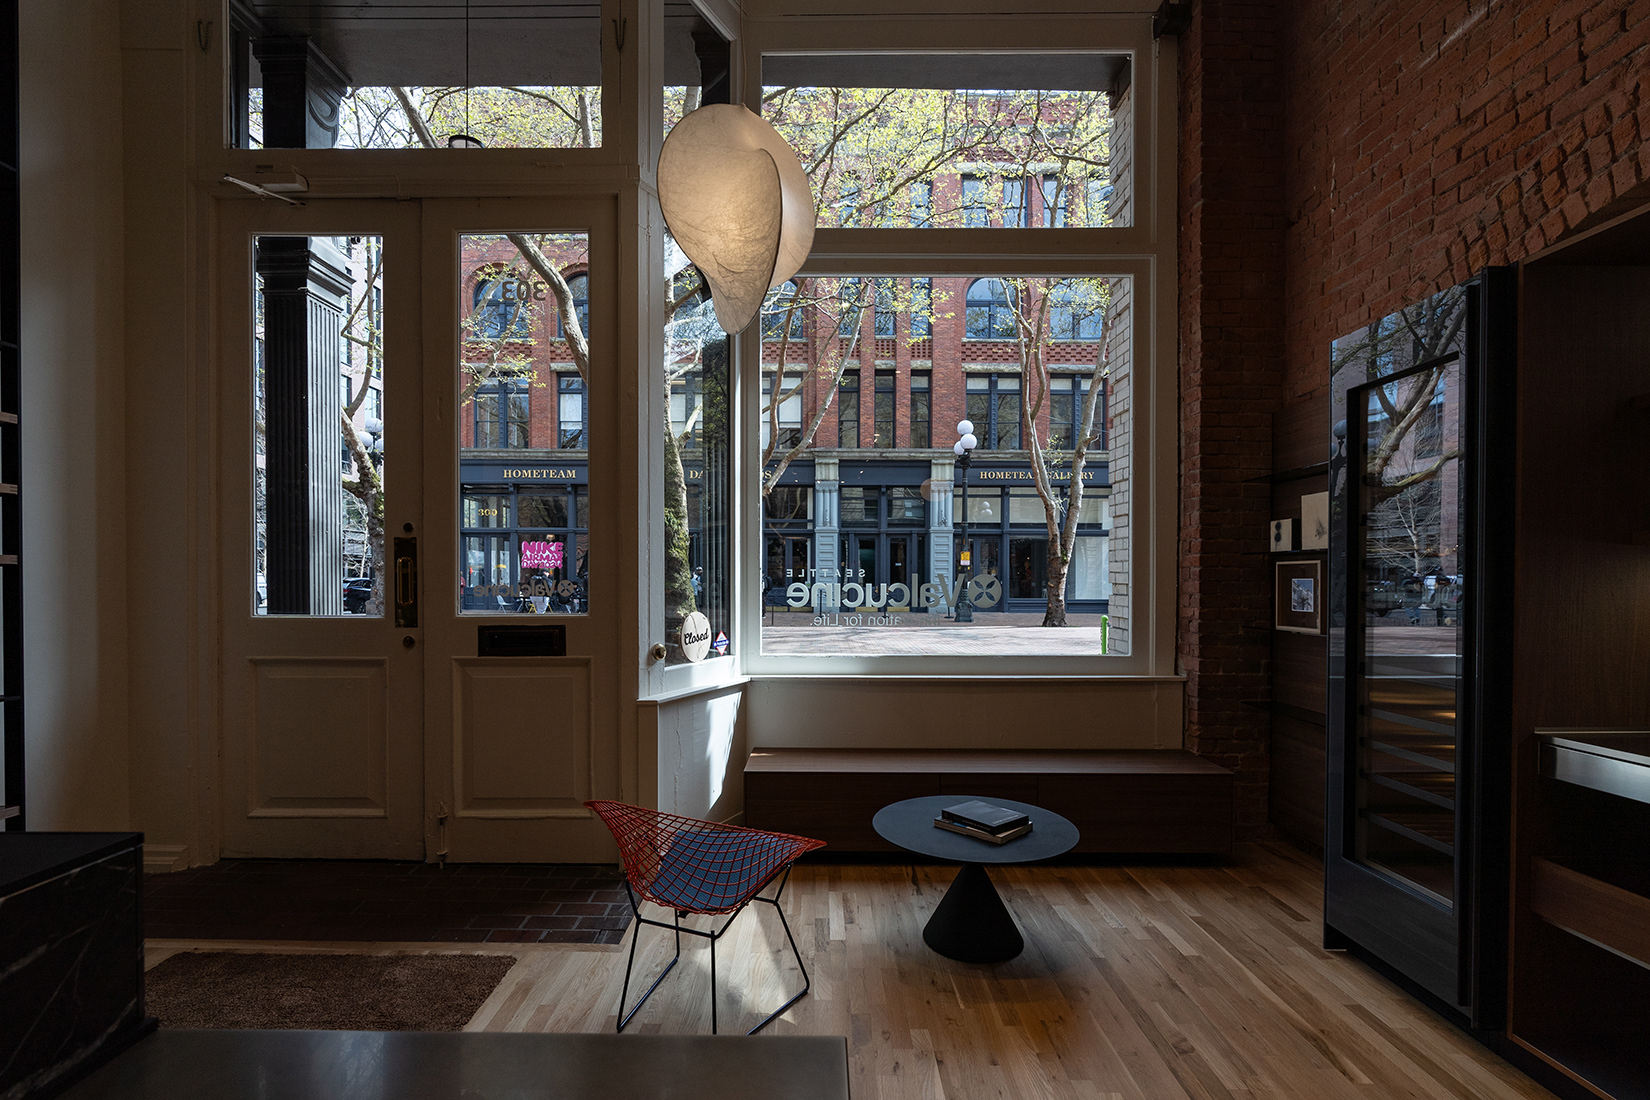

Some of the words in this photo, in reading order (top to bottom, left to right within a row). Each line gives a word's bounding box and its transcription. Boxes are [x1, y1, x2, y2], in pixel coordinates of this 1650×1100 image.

[502, 469, 577, 478] HOMETEAM
[979, 471, 1034, 480] HOMETEA
[1047, 471, 1095, 480] GALLRY
[477, 508, 498, 517] 300
[521, 541, 564, 554] NIKE
[684, 628, 709, 646] Closed
